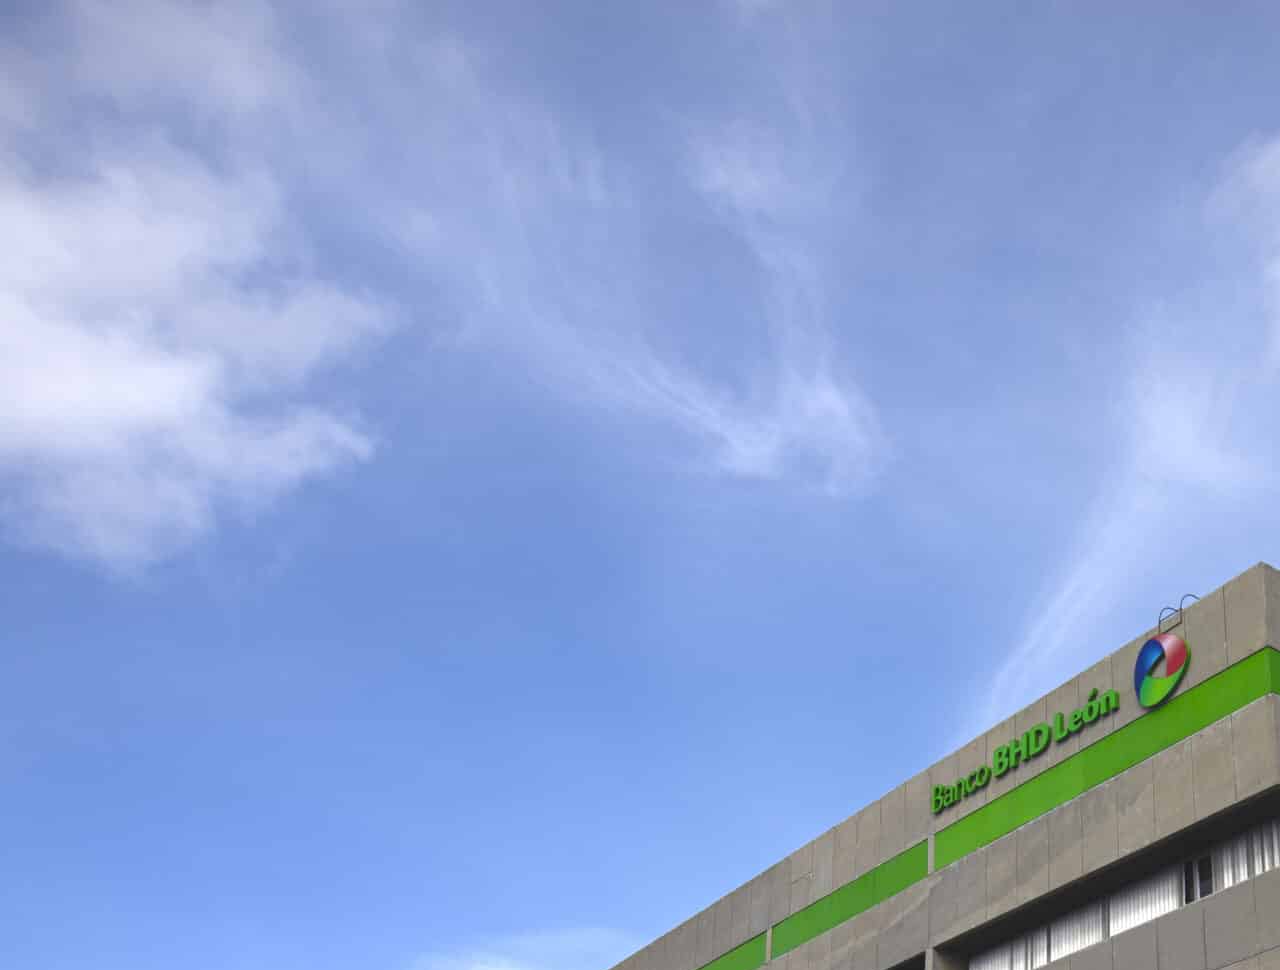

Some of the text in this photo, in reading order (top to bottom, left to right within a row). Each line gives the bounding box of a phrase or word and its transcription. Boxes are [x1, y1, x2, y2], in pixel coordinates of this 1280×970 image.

[931, 687, 1120, 814] Banco BHD León
